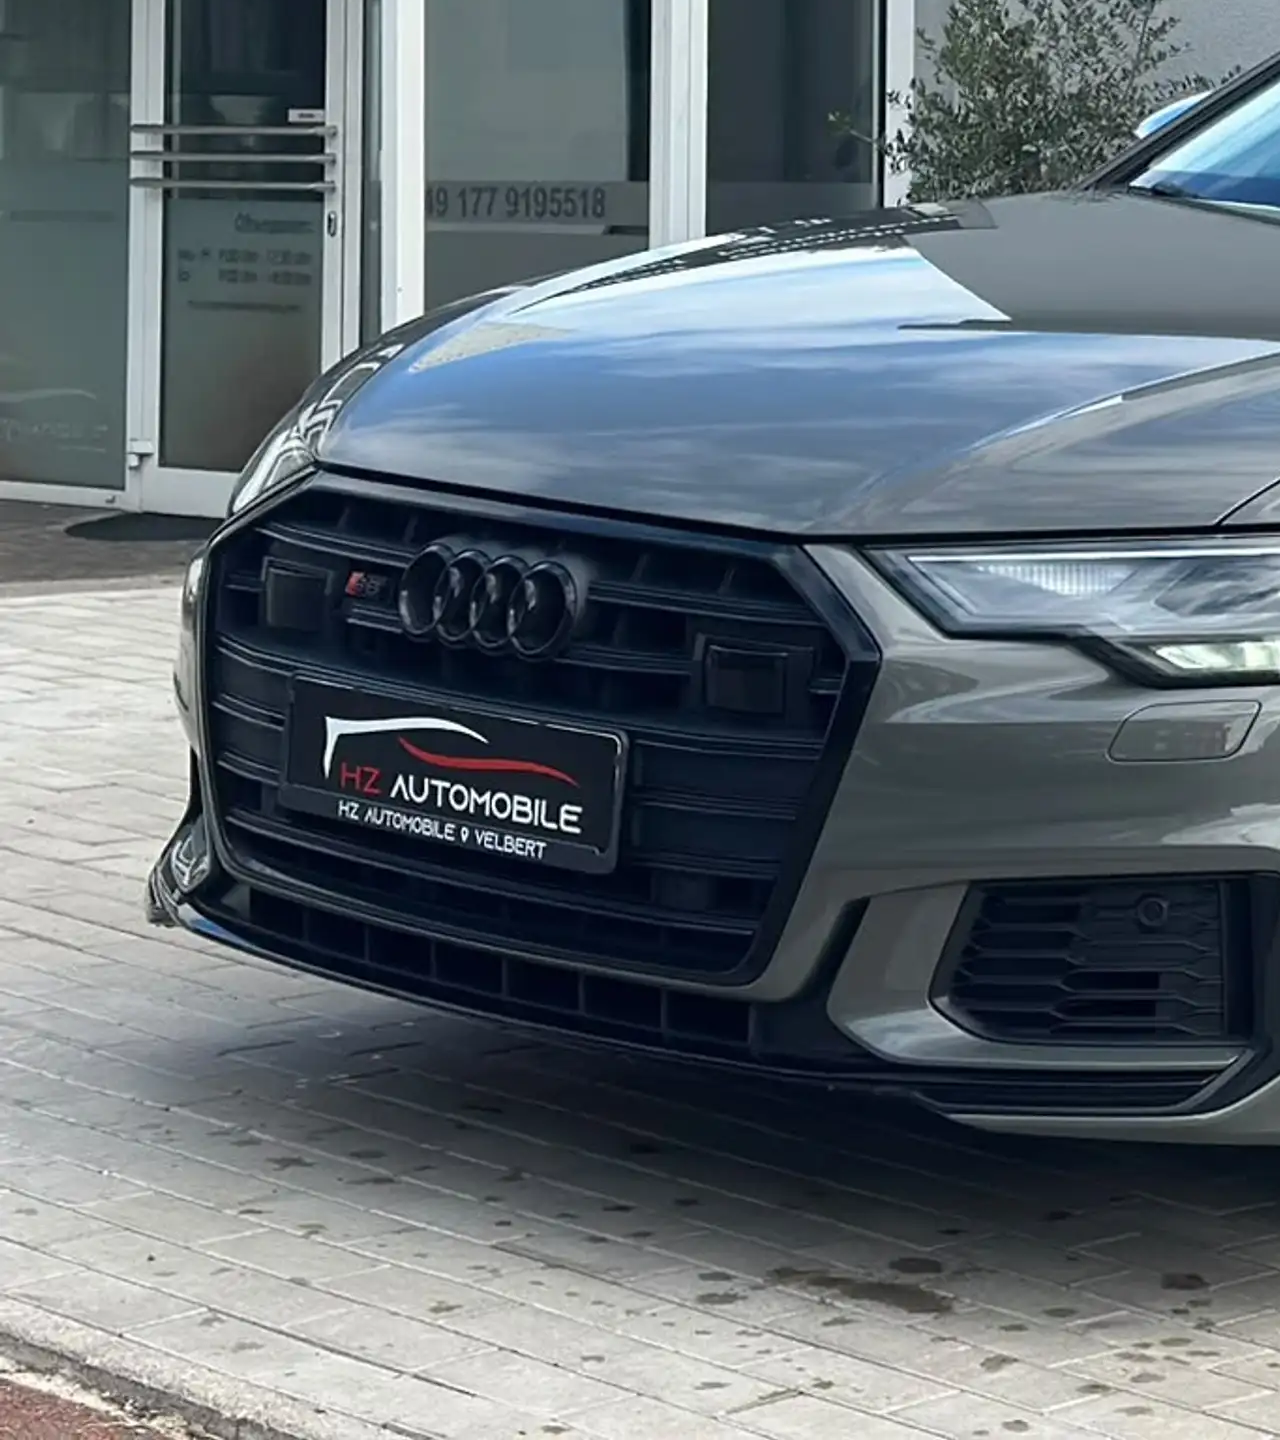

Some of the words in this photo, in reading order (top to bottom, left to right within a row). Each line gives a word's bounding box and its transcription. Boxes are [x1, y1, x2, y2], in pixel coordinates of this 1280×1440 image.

[457, 186, 498, 218] 177
[504, 186, 606, 218] 9195518
[339, 762, 382, 795] HZ
[390, 773, 583, 835] AUTOMOBILE
[337, 800, 360, 821] HZ
[364, 808, 456, 842] AUTOMOBILE
[475, 828, 548, 860] VELBERT
